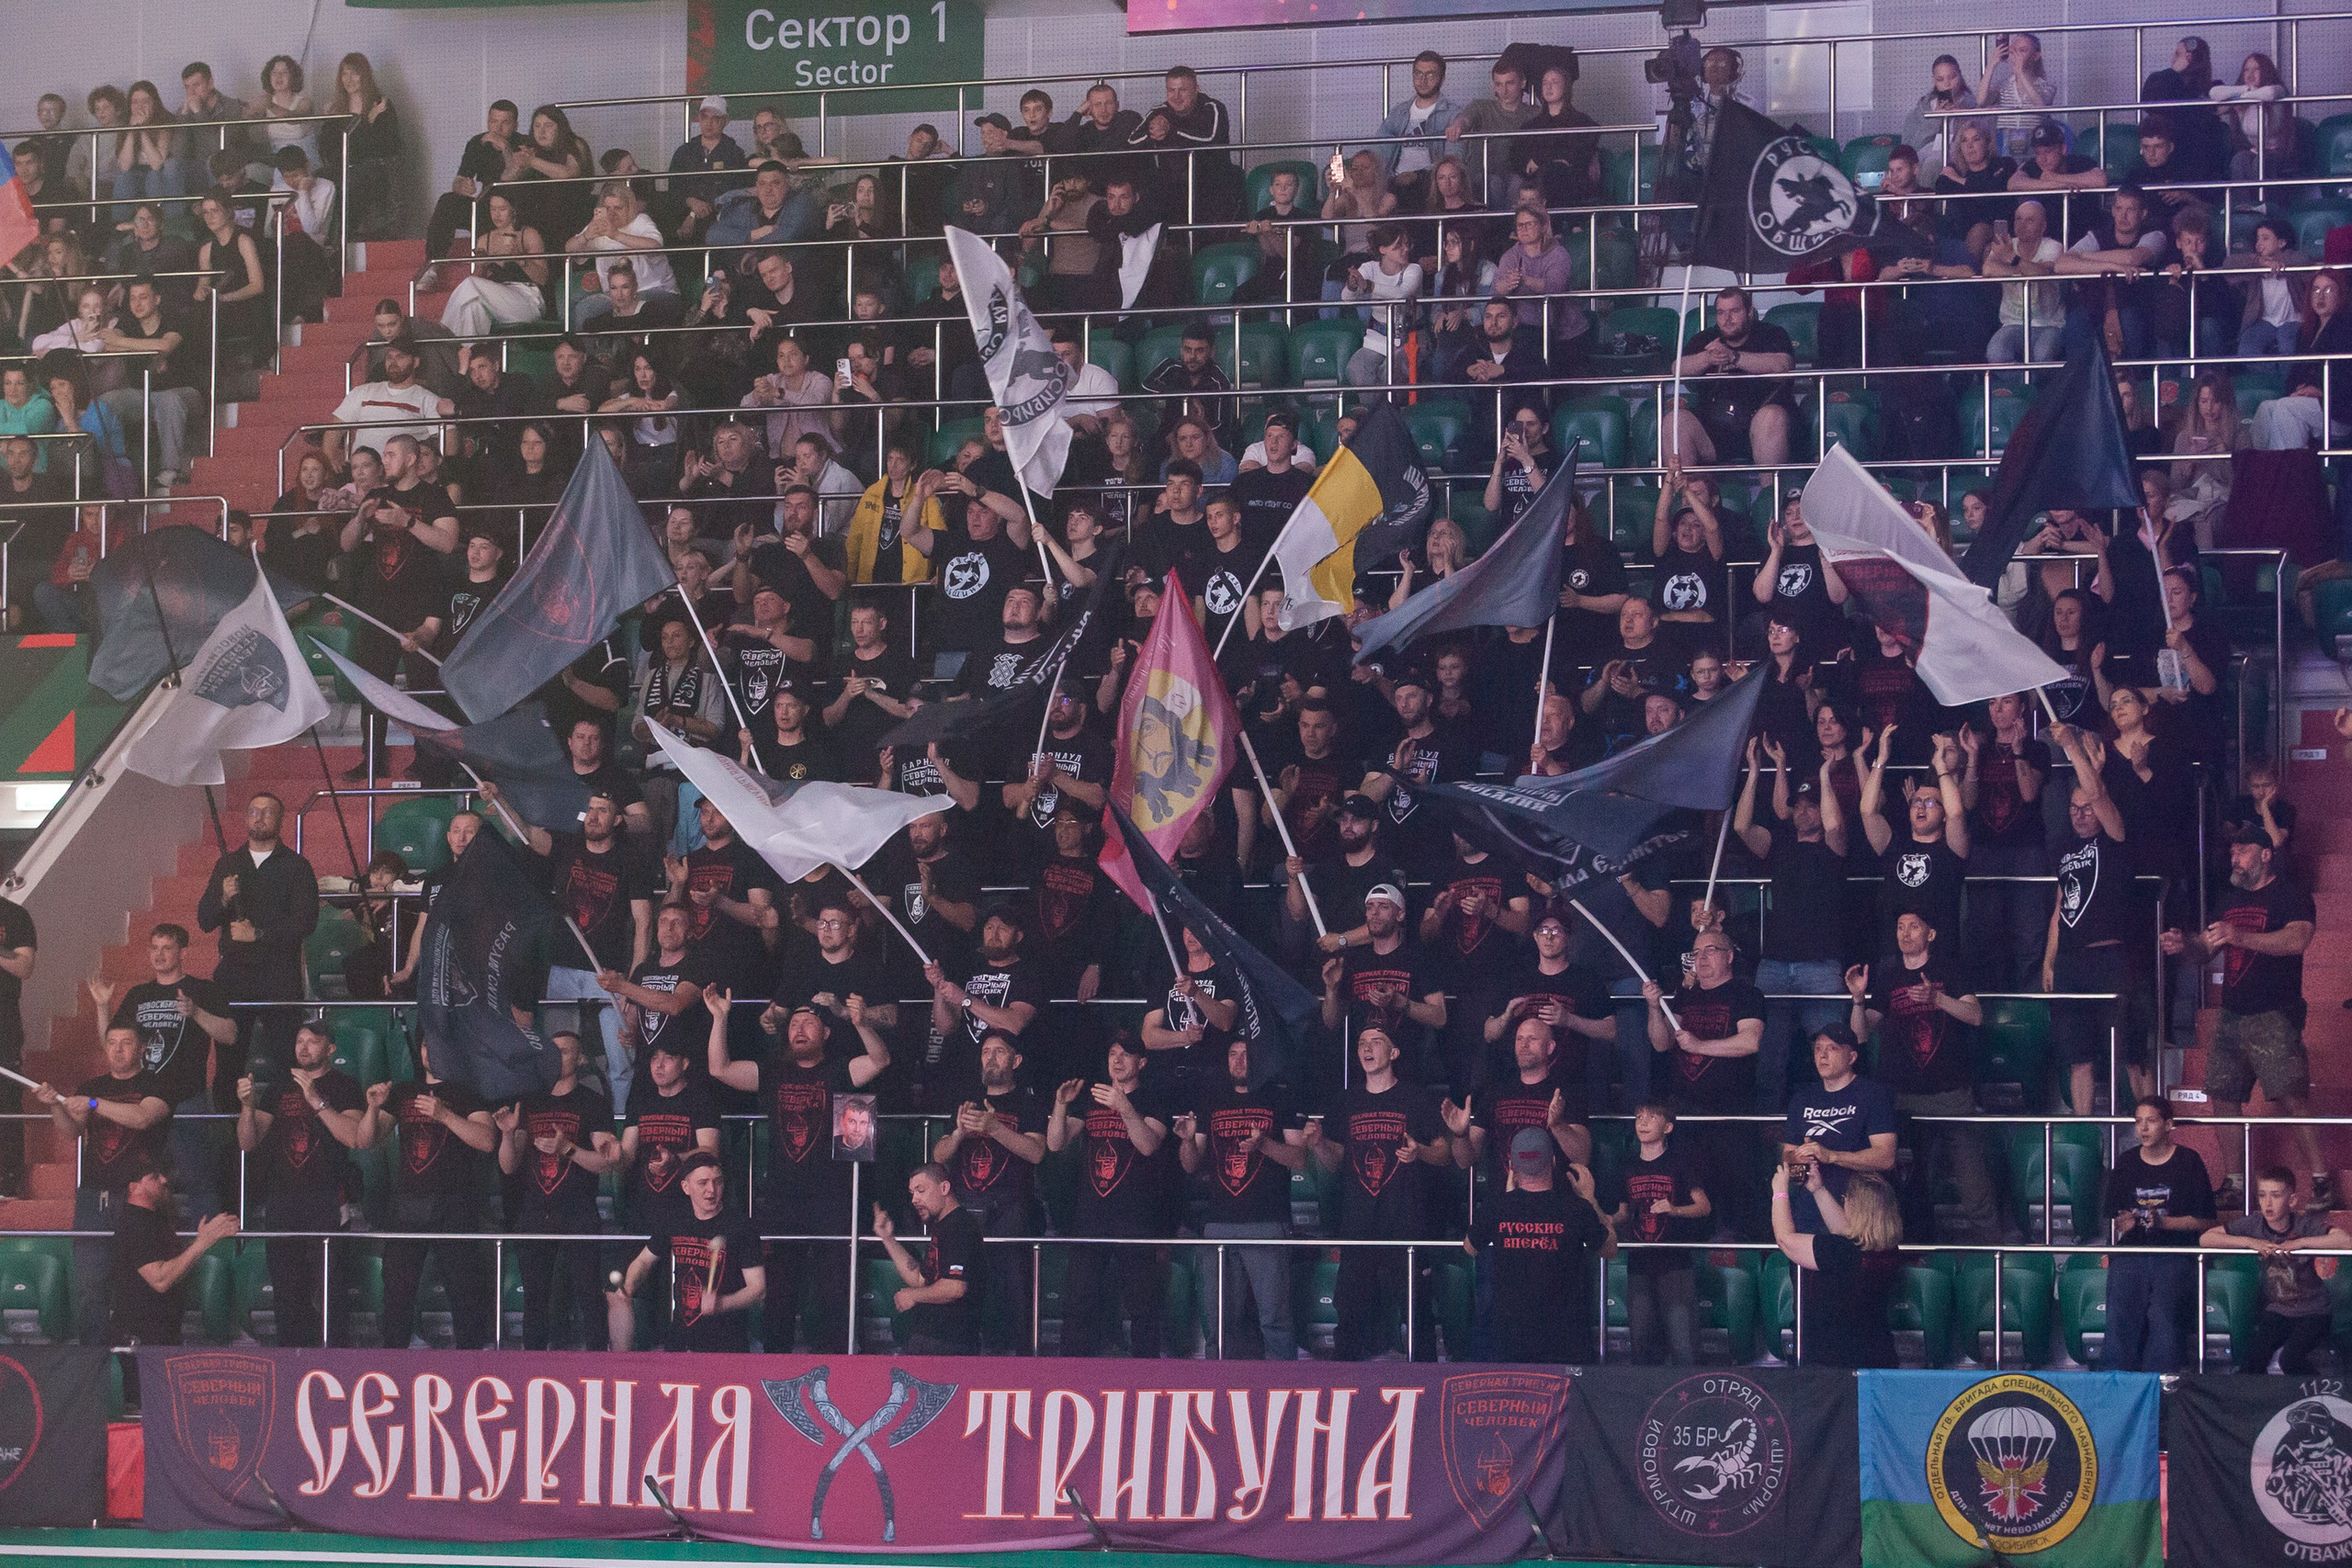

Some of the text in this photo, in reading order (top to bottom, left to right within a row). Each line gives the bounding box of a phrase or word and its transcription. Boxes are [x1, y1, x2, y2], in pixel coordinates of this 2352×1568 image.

[745, 1, 946, 56] Сектор 1
[796, 60, 894, 86] Sector
[2177, 1091, 2194, 1100] РЯД
[1803, 1104, 1857, 1120] Reebok
[1498, 1222, 1564, 1234] РУССКИЕ
[1503, 1237, 1558, 1250] ВПЕРЁД
[185, 1379, 262, 1395] СЕВЕРНЫЙ
[1451, 1377, 1561, 1393] СЕВЕРНАЯ ТРИБУНА
[192, 1394, 256, 1406] ЧЕЛОВЕК
[1703, 1379, 1762, 1412] ОТРЯД
[1456, 1399, 1547, 1416] СЕВЕРНЫЙ
[1464, 1416, 1539, 1428] ЧЕЛОВЕК
[1673, 1426, 1718, 1447] 35 БР
[1931, 1433, 1945, 1500] ОТДЕЛЬНАЯ
[1953, 1382, 1998, 1414] БРИГАДА
[2002, 1378, 2079, 1425] СПЕЦИАЛЬНОГО
[2075, 1427, 2094, 1501] НАЗНАЧЕНИЯ
[294, 1370, 1426, 1523] СЕВЕРНАЯ ТРИБУНА
[1642, 1418, 1697, 1526] ШТУРМОВОЙ
[1742, 1438, 1784, 1516] «ШТОРМ»
[2284, 1541, 2352, 1562] ОТВАЖ
